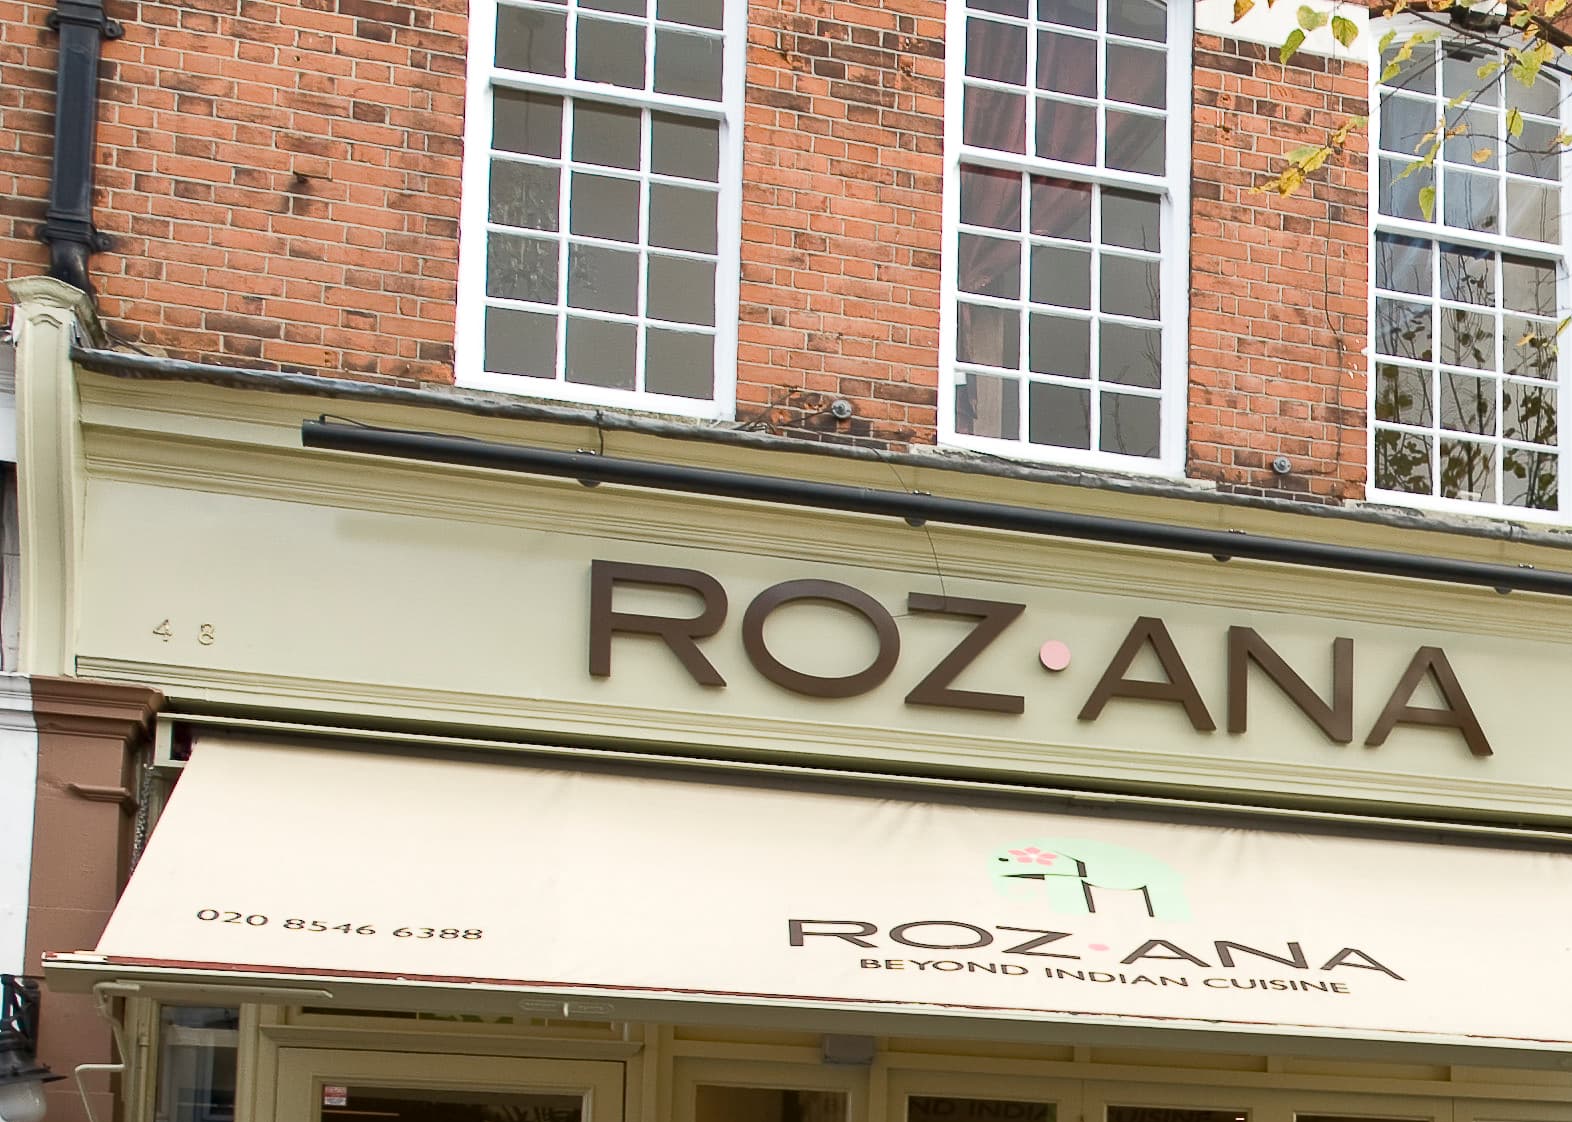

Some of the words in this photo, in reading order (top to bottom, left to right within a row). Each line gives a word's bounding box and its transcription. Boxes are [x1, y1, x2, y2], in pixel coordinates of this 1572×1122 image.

[195, 907, 269, 928] 020
[283, 917, 377, 937] 8546
[391, 924, 484, 943] 6388
[859, 957, 1029, 979] BEYOND
[1044, 967, 1189, 990] INDIAN
[1204, 976, 1352, 997] CUISINE
